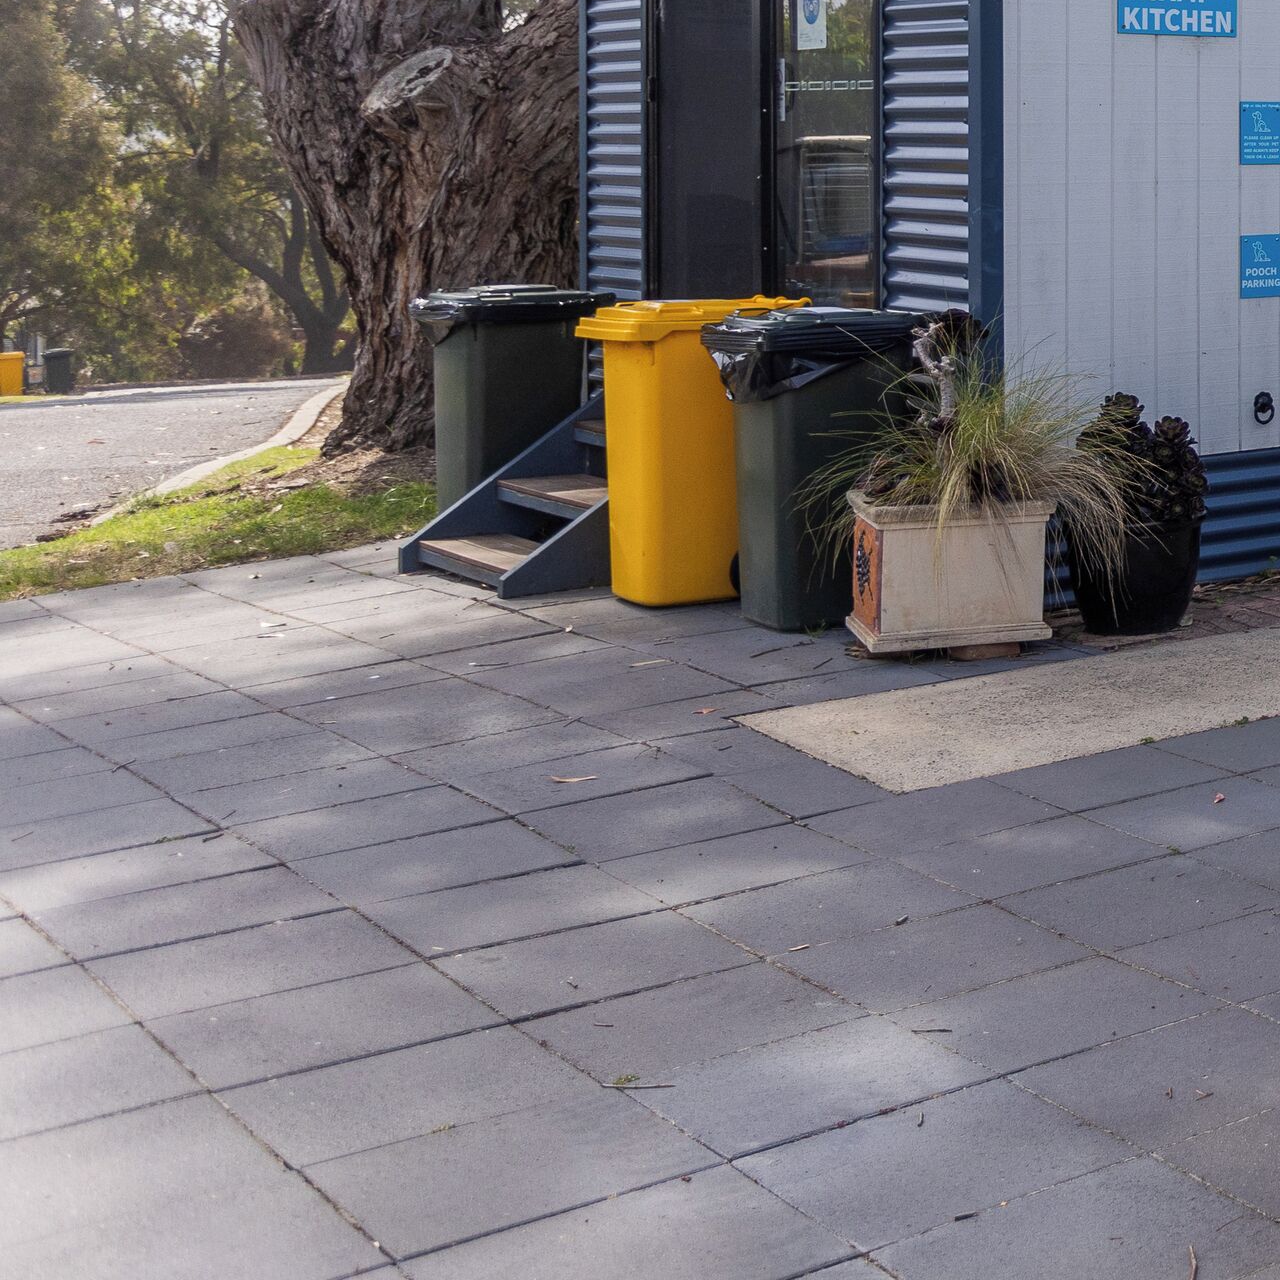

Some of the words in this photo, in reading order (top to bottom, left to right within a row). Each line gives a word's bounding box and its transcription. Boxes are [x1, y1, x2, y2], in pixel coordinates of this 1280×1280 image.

[1124, 7, 1232, 33] KITCHEN
[1245, 267, 1277, 277] POOCH
[1241, 278, 1280, 289] PARKING
